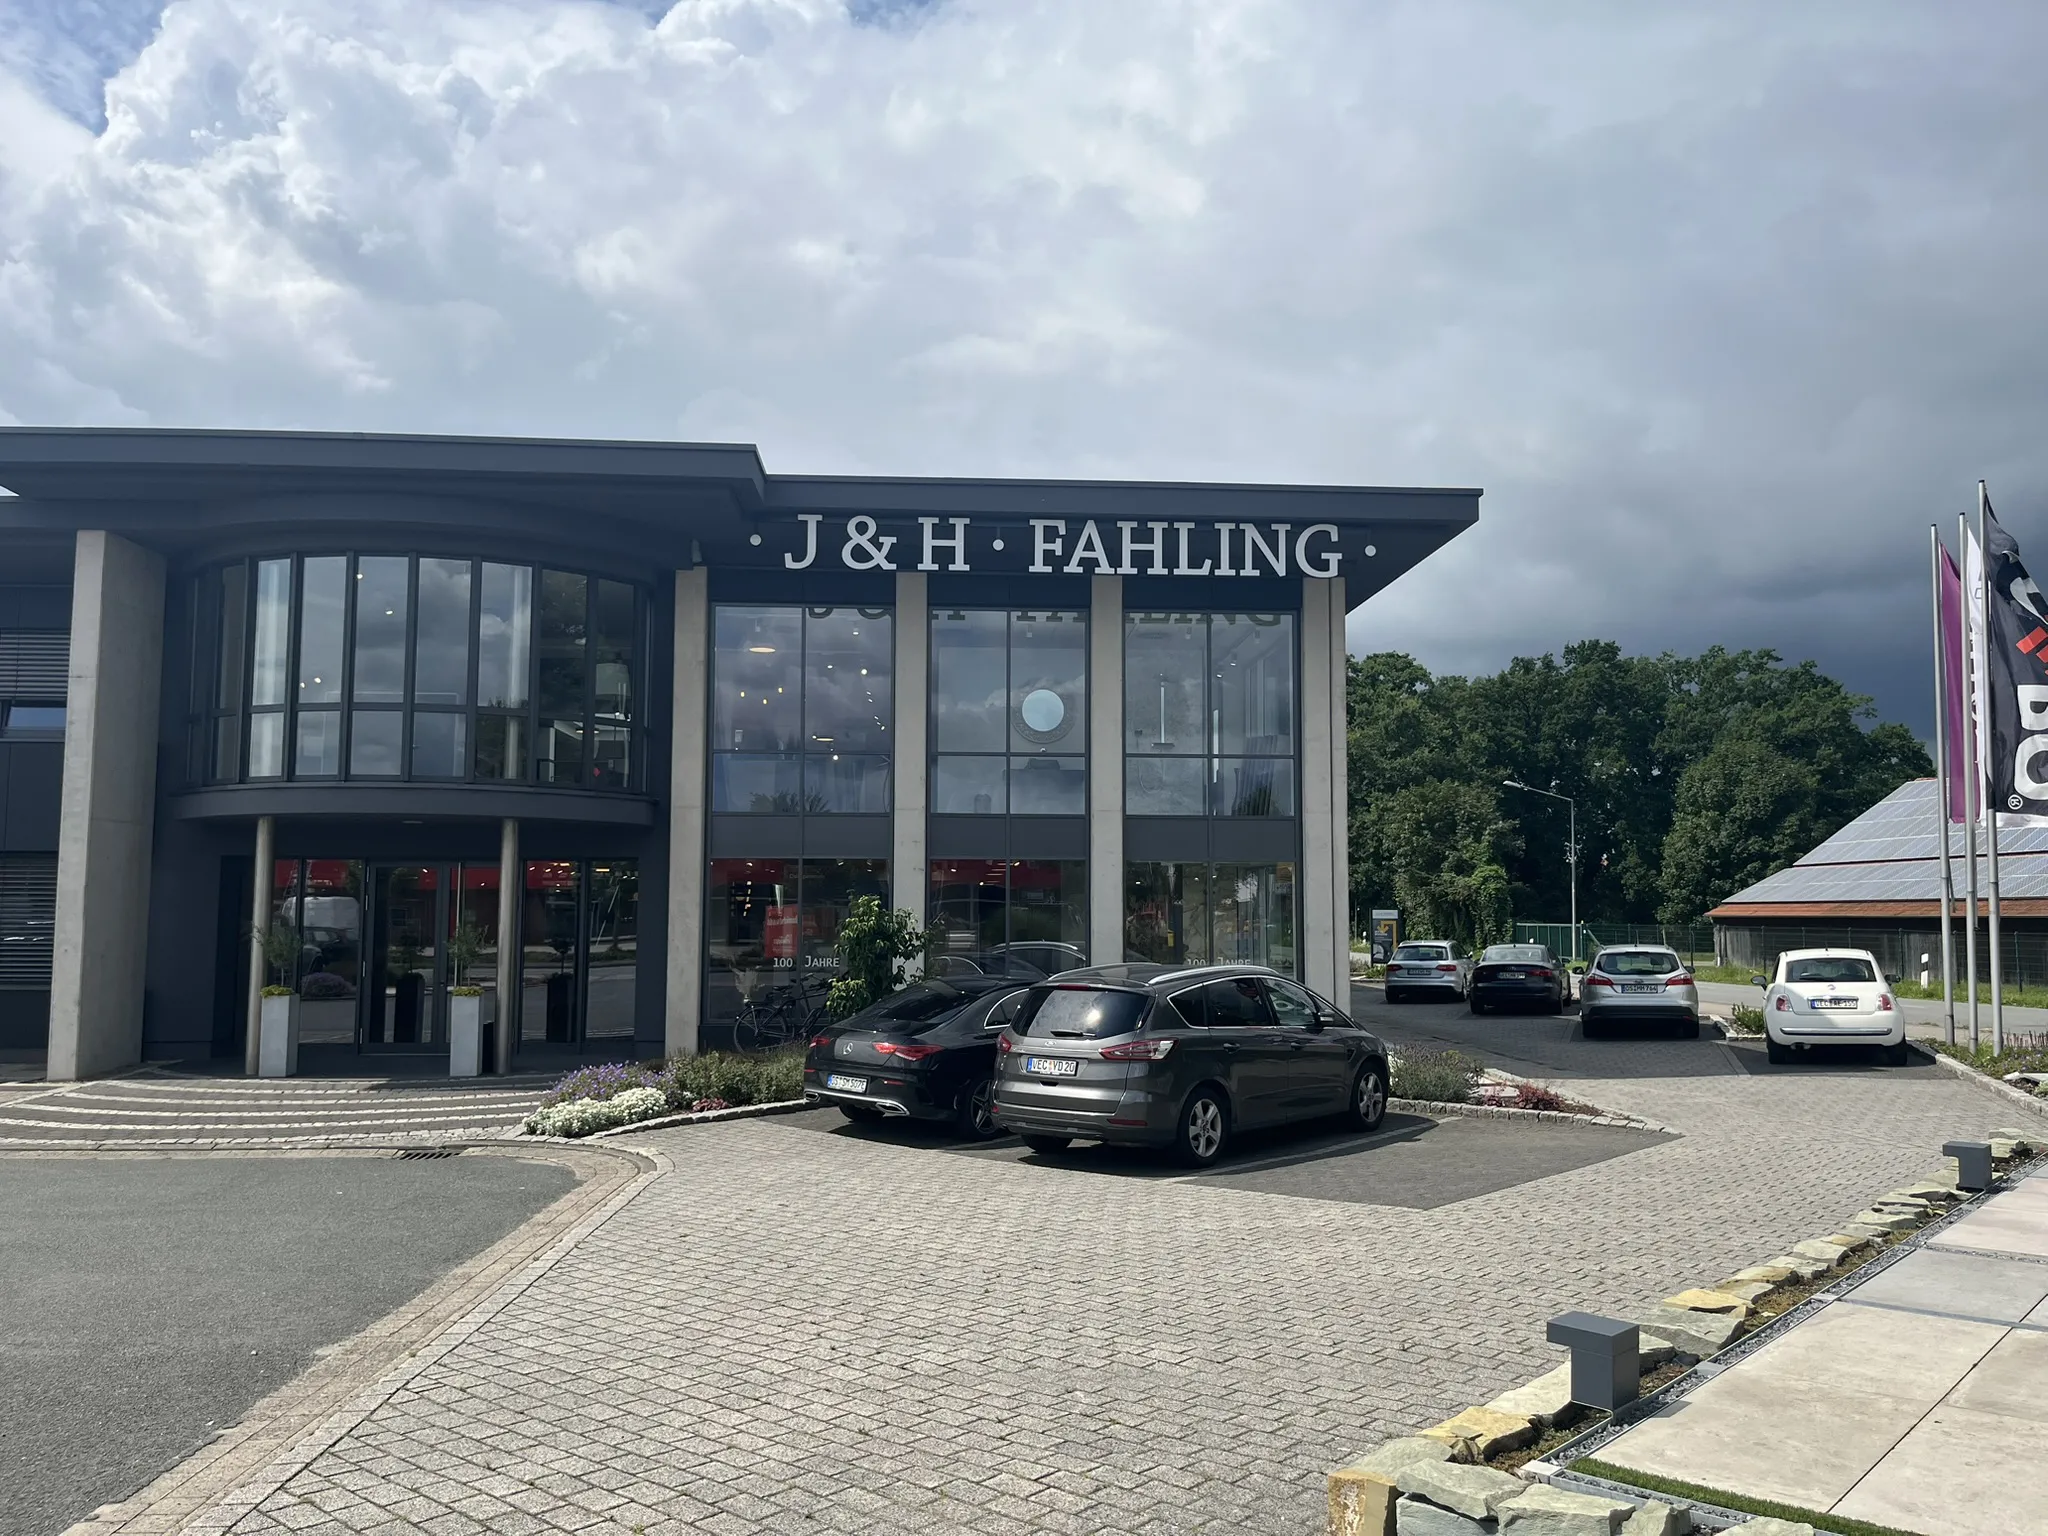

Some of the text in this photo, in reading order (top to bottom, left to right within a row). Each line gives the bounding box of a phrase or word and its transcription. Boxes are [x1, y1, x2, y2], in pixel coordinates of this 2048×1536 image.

[784, 514, 1342, 578] J & H FAHLING
[773, 955, 840, 968] 100 JAHRE
[1033, 1059, 1048, 1071] VEC
